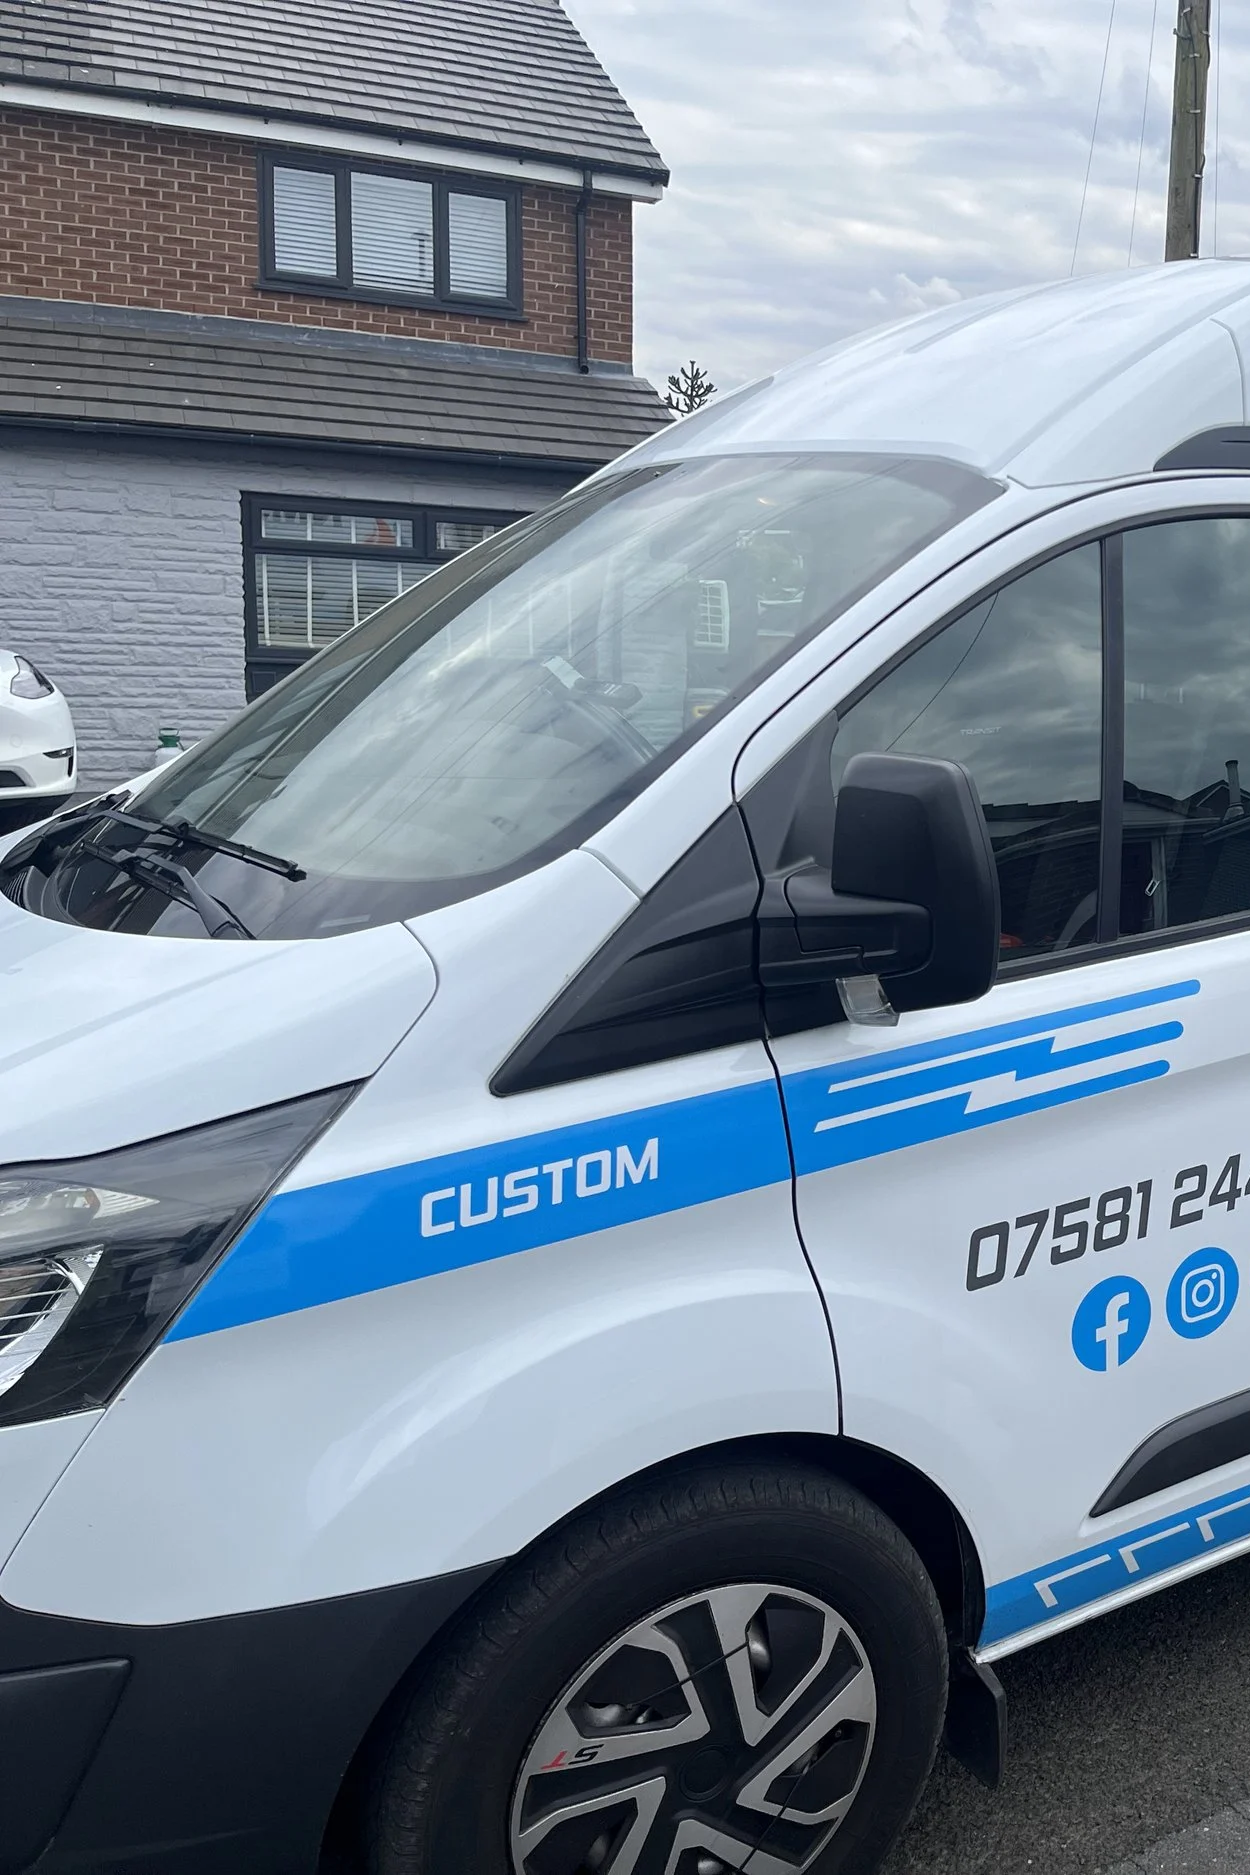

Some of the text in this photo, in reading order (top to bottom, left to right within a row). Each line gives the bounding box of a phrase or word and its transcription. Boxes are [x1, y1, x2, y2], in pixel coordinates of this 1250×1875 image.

[959, 726, 1002, 737] TRANSIT
[421, 1137, 659, 1238] CUSTOM
[965, 1178, 1153, 1292] 07581
[540, 1743, 605, 1771] ST
